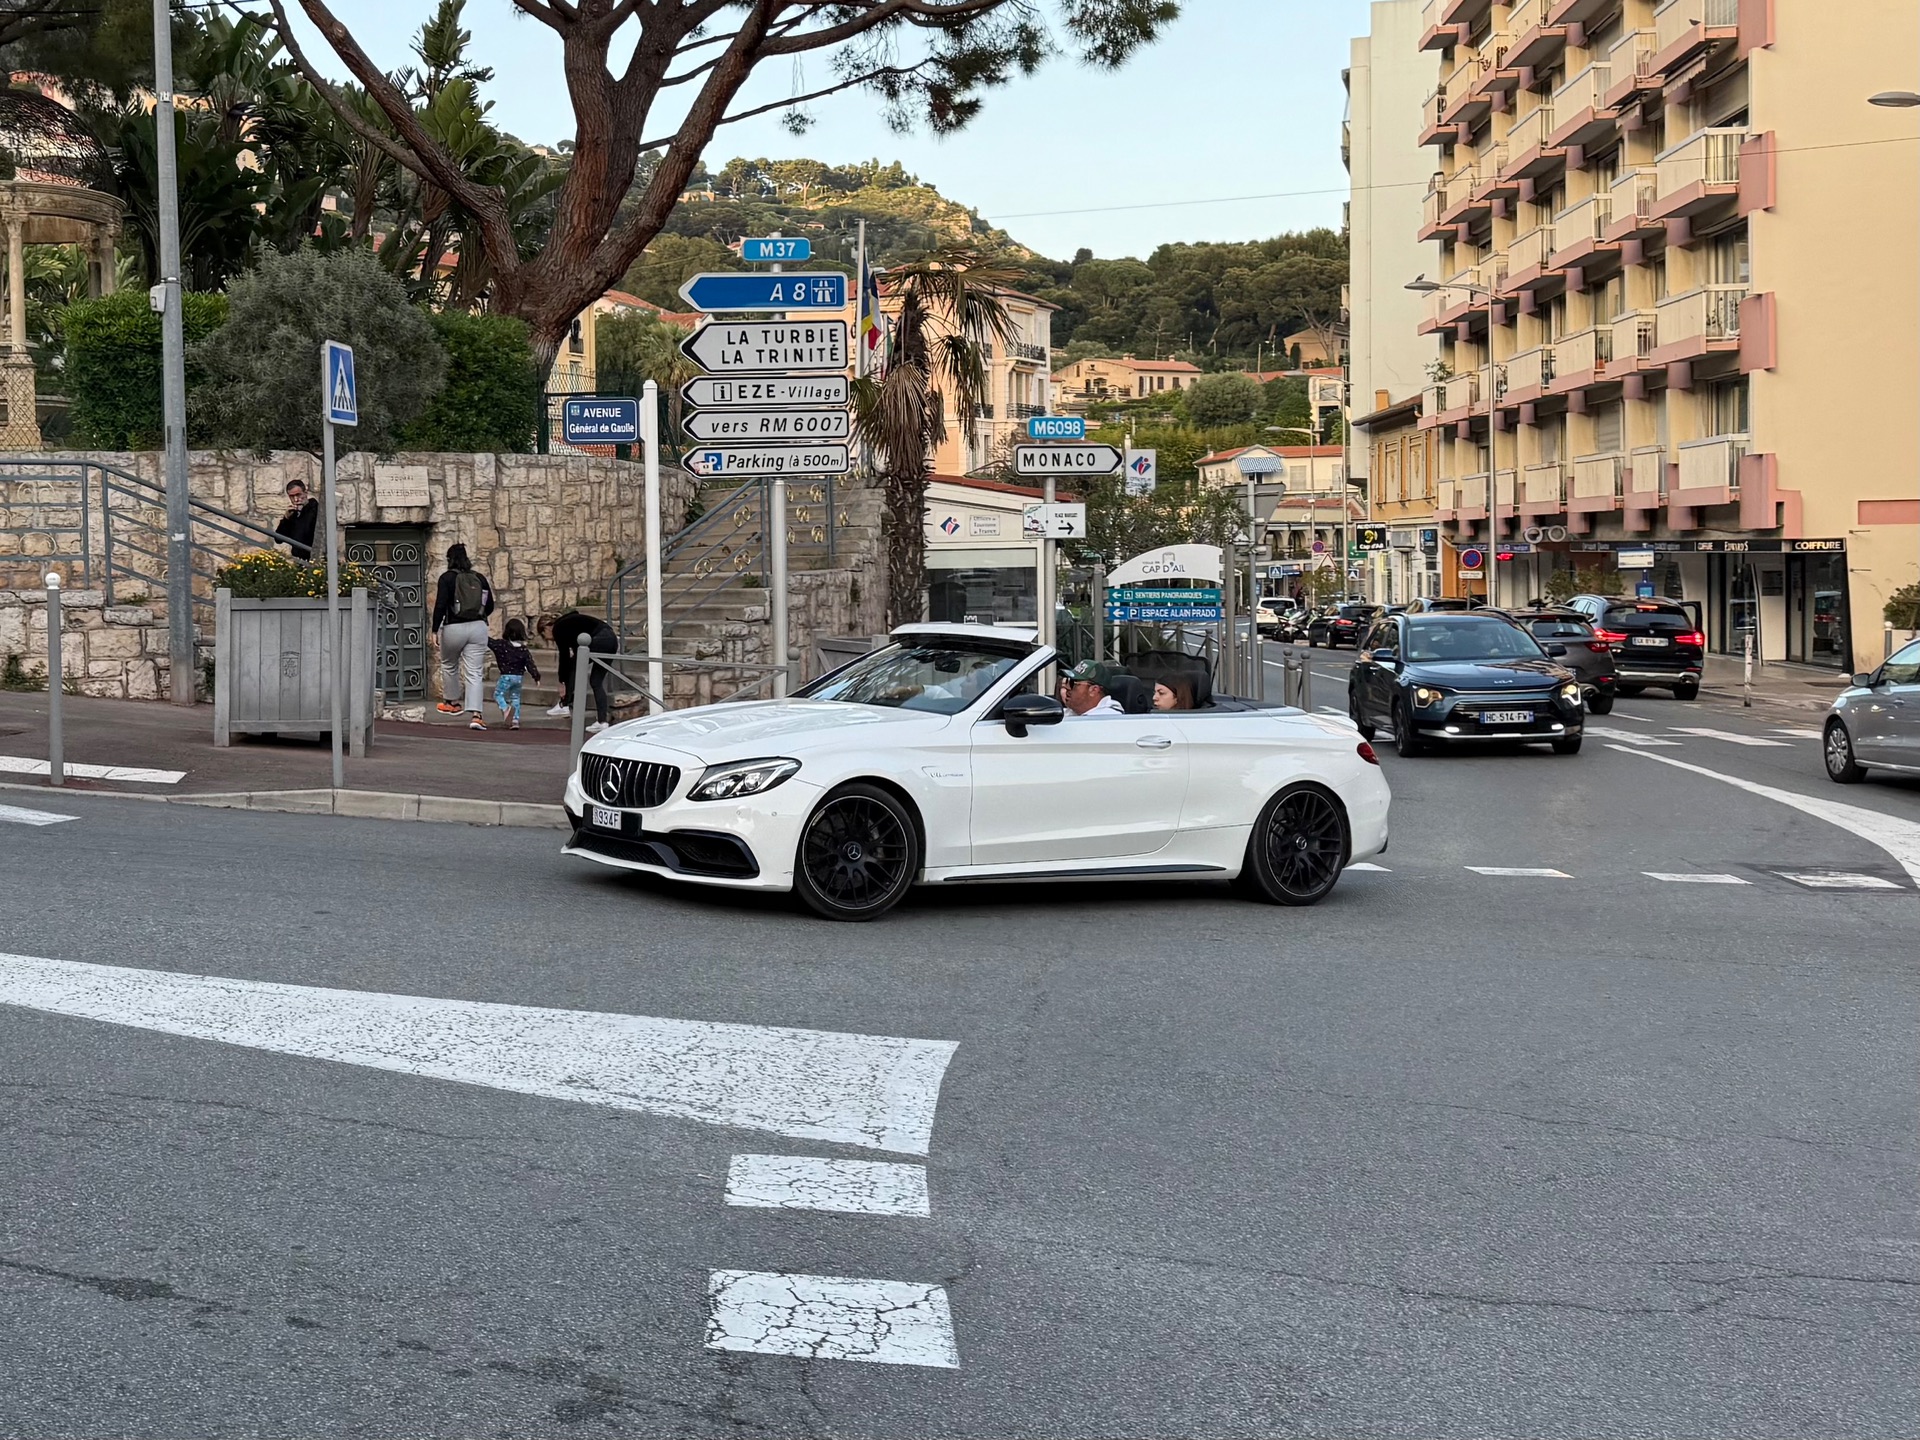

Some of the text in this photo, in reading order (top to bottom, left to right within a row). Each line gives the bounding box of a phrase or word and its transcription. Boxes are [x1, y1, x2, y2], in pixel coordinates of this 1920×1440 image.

[760, 242, 795, 257] M37
[770, 283, 806, 301] A 8
[727, 328, 839, 345] LA TURBIE
[722, 344, 840, 364] LA TRINITÉ
[583, 407, 622, 418] AVENUE
[569, 423, 635, 434] Général de Gaulle
[711, 417, 843, 433] vers RM 6007
[1034, 421, 1080, 435] M6098
[727, 454, 784, 471] Parking
[803, 453, 844, 467] 500m)
[1023, 452, 1096, 467] MONACO
[1795, 541, 1842, 550] COIFFURE
[1142, 565, 1160, 574] CAP
[1161, 591, 1202, 599] PANORAMIQUES
[1141, 609, 1169, 618] ESPACE
[1170, 609, 1191, 618] ALAIN
[1192, 608, 1216, 618] PRADO
